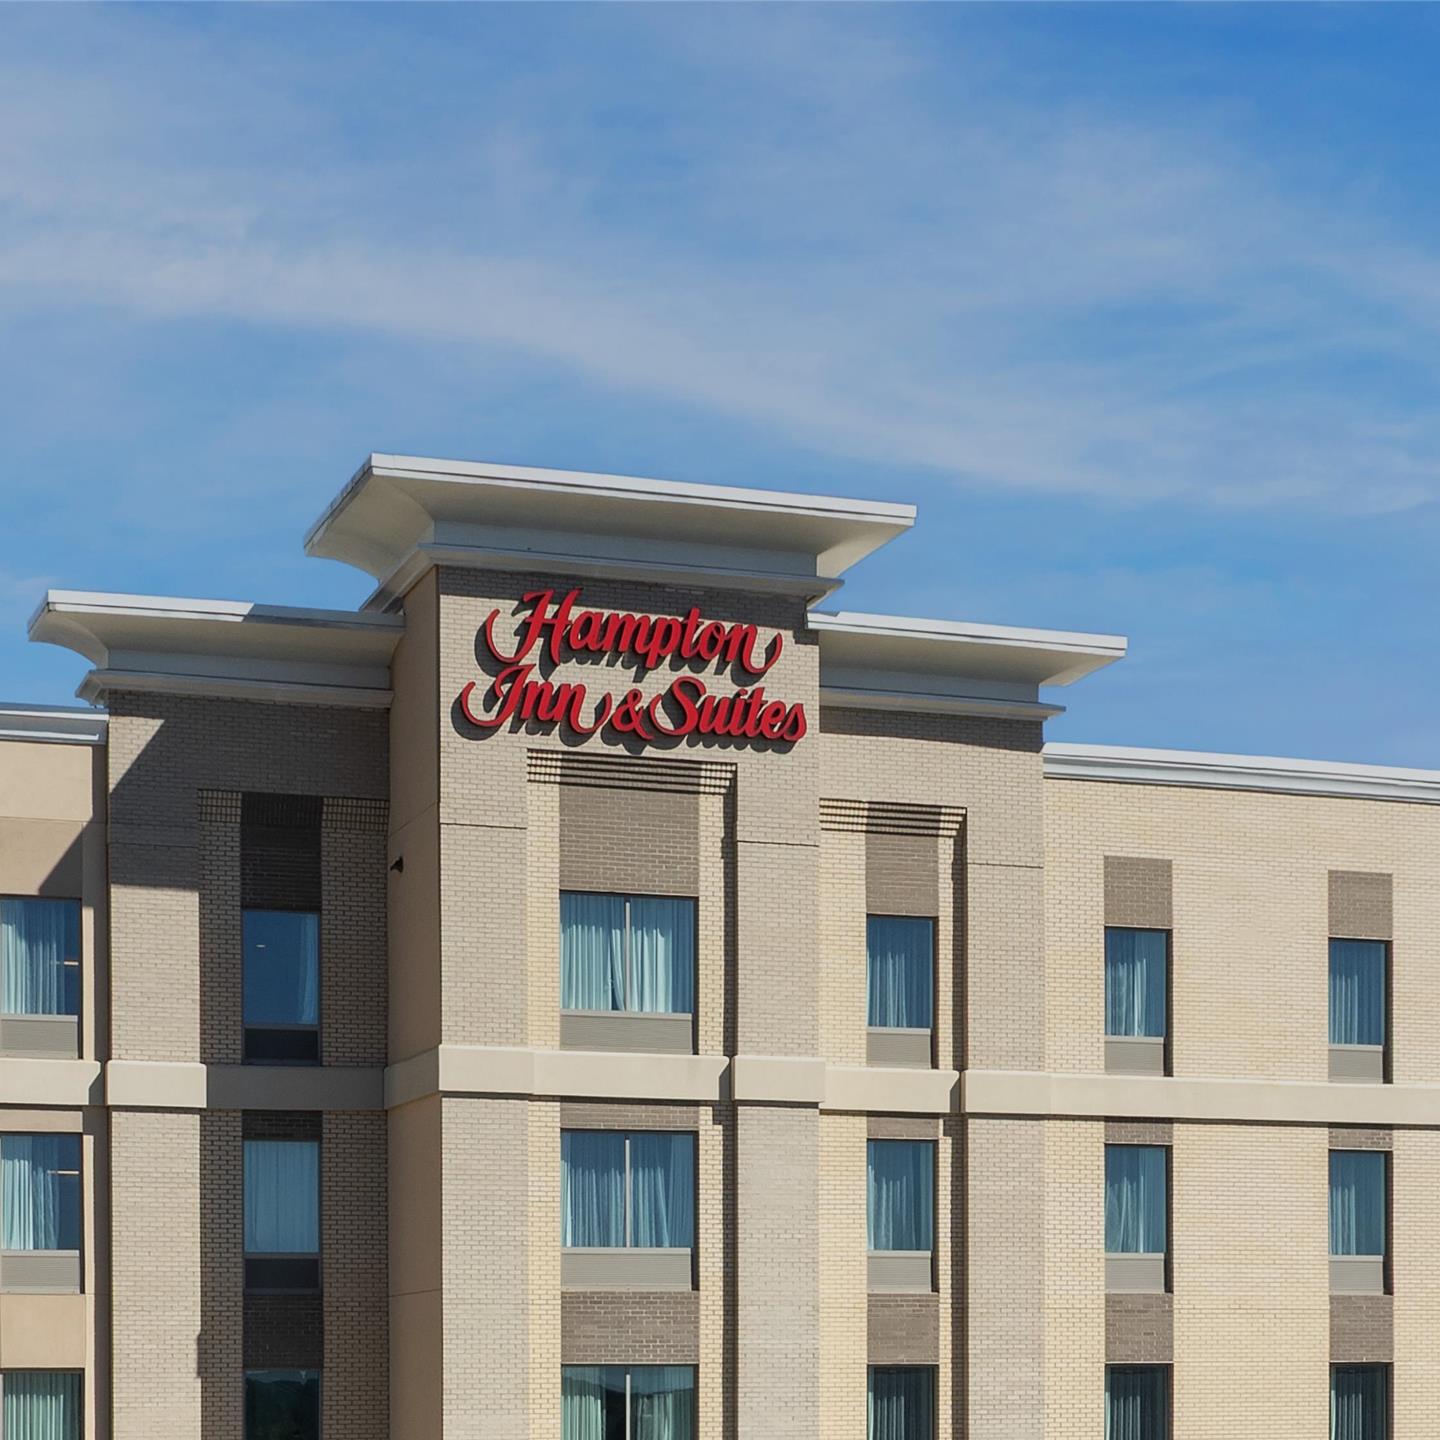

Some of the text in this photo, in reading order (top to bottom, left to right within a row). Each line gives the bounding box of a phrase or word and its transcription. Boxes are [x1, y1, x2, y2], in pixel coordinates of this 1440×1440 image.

[486, 588, 783, 674] Hampton
[460, 664, 807, 742] Inn & Suites
